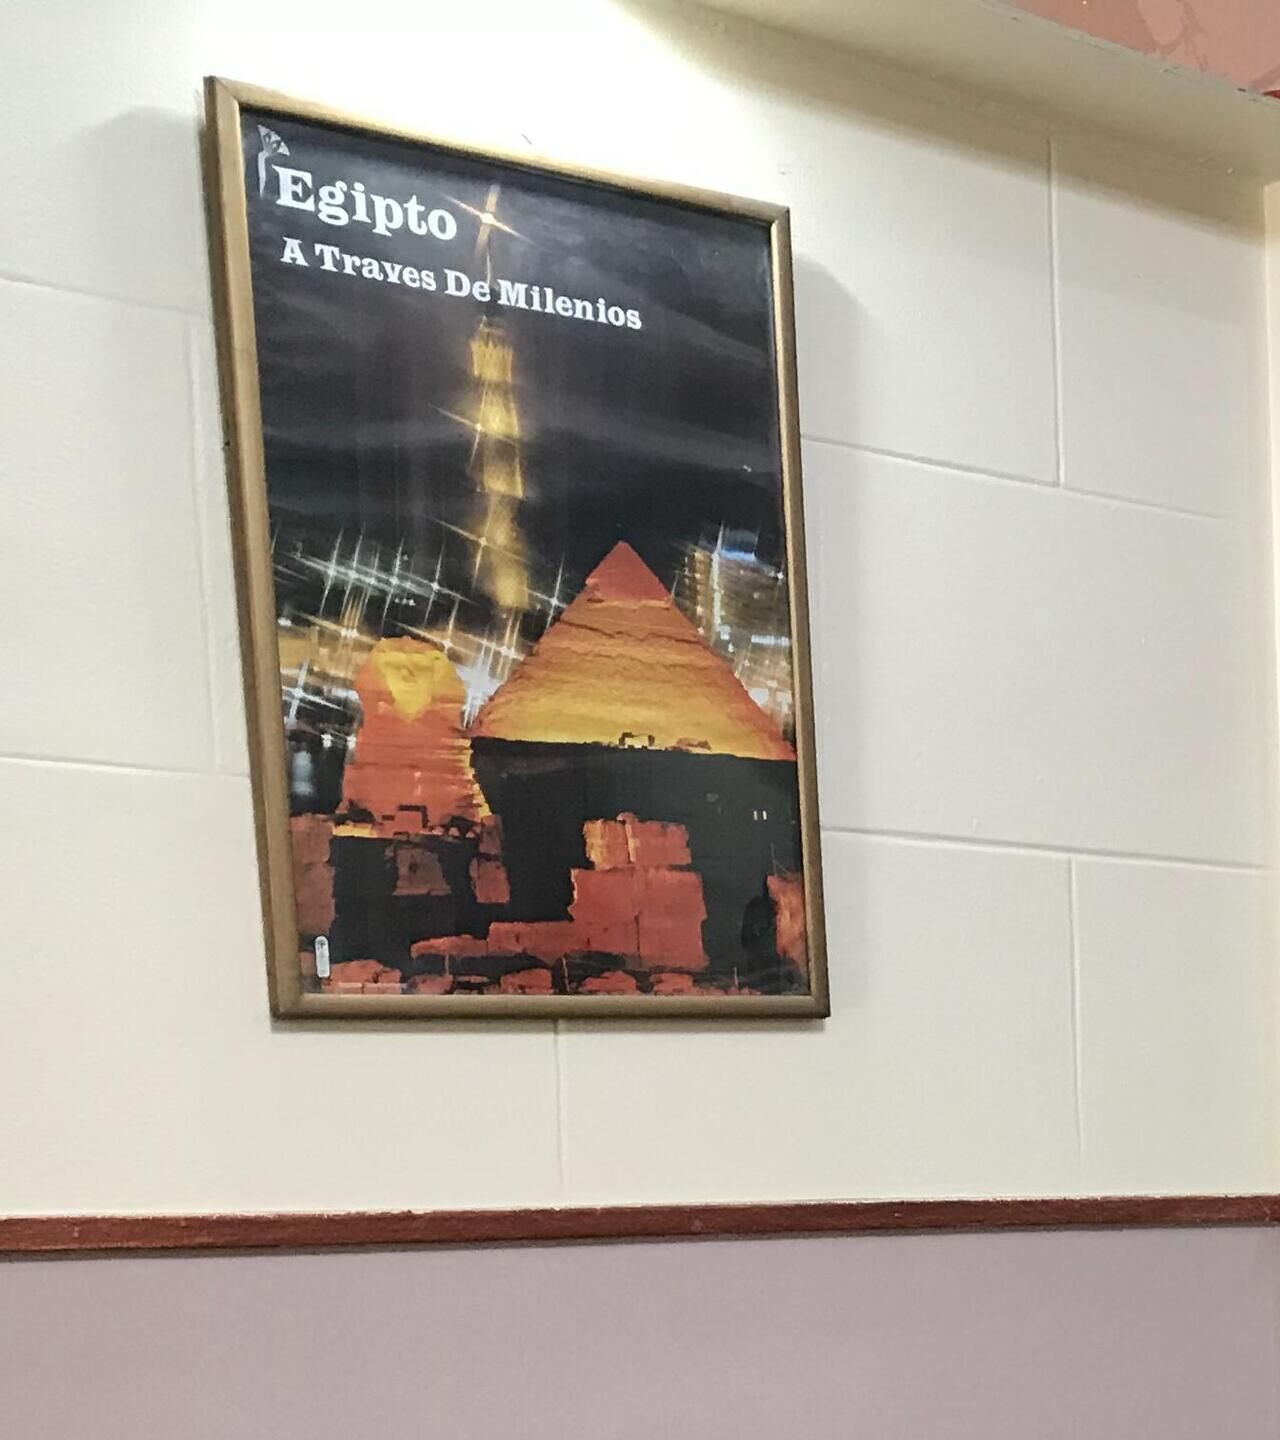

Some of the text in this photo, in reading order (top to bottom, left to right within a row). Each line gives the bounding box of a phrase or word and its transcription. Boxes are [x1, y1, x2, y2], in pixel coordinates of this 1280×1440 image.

[272, 164, 457, 241] Egipto
[280, 236, 643, 331] A Traves De Milenios
